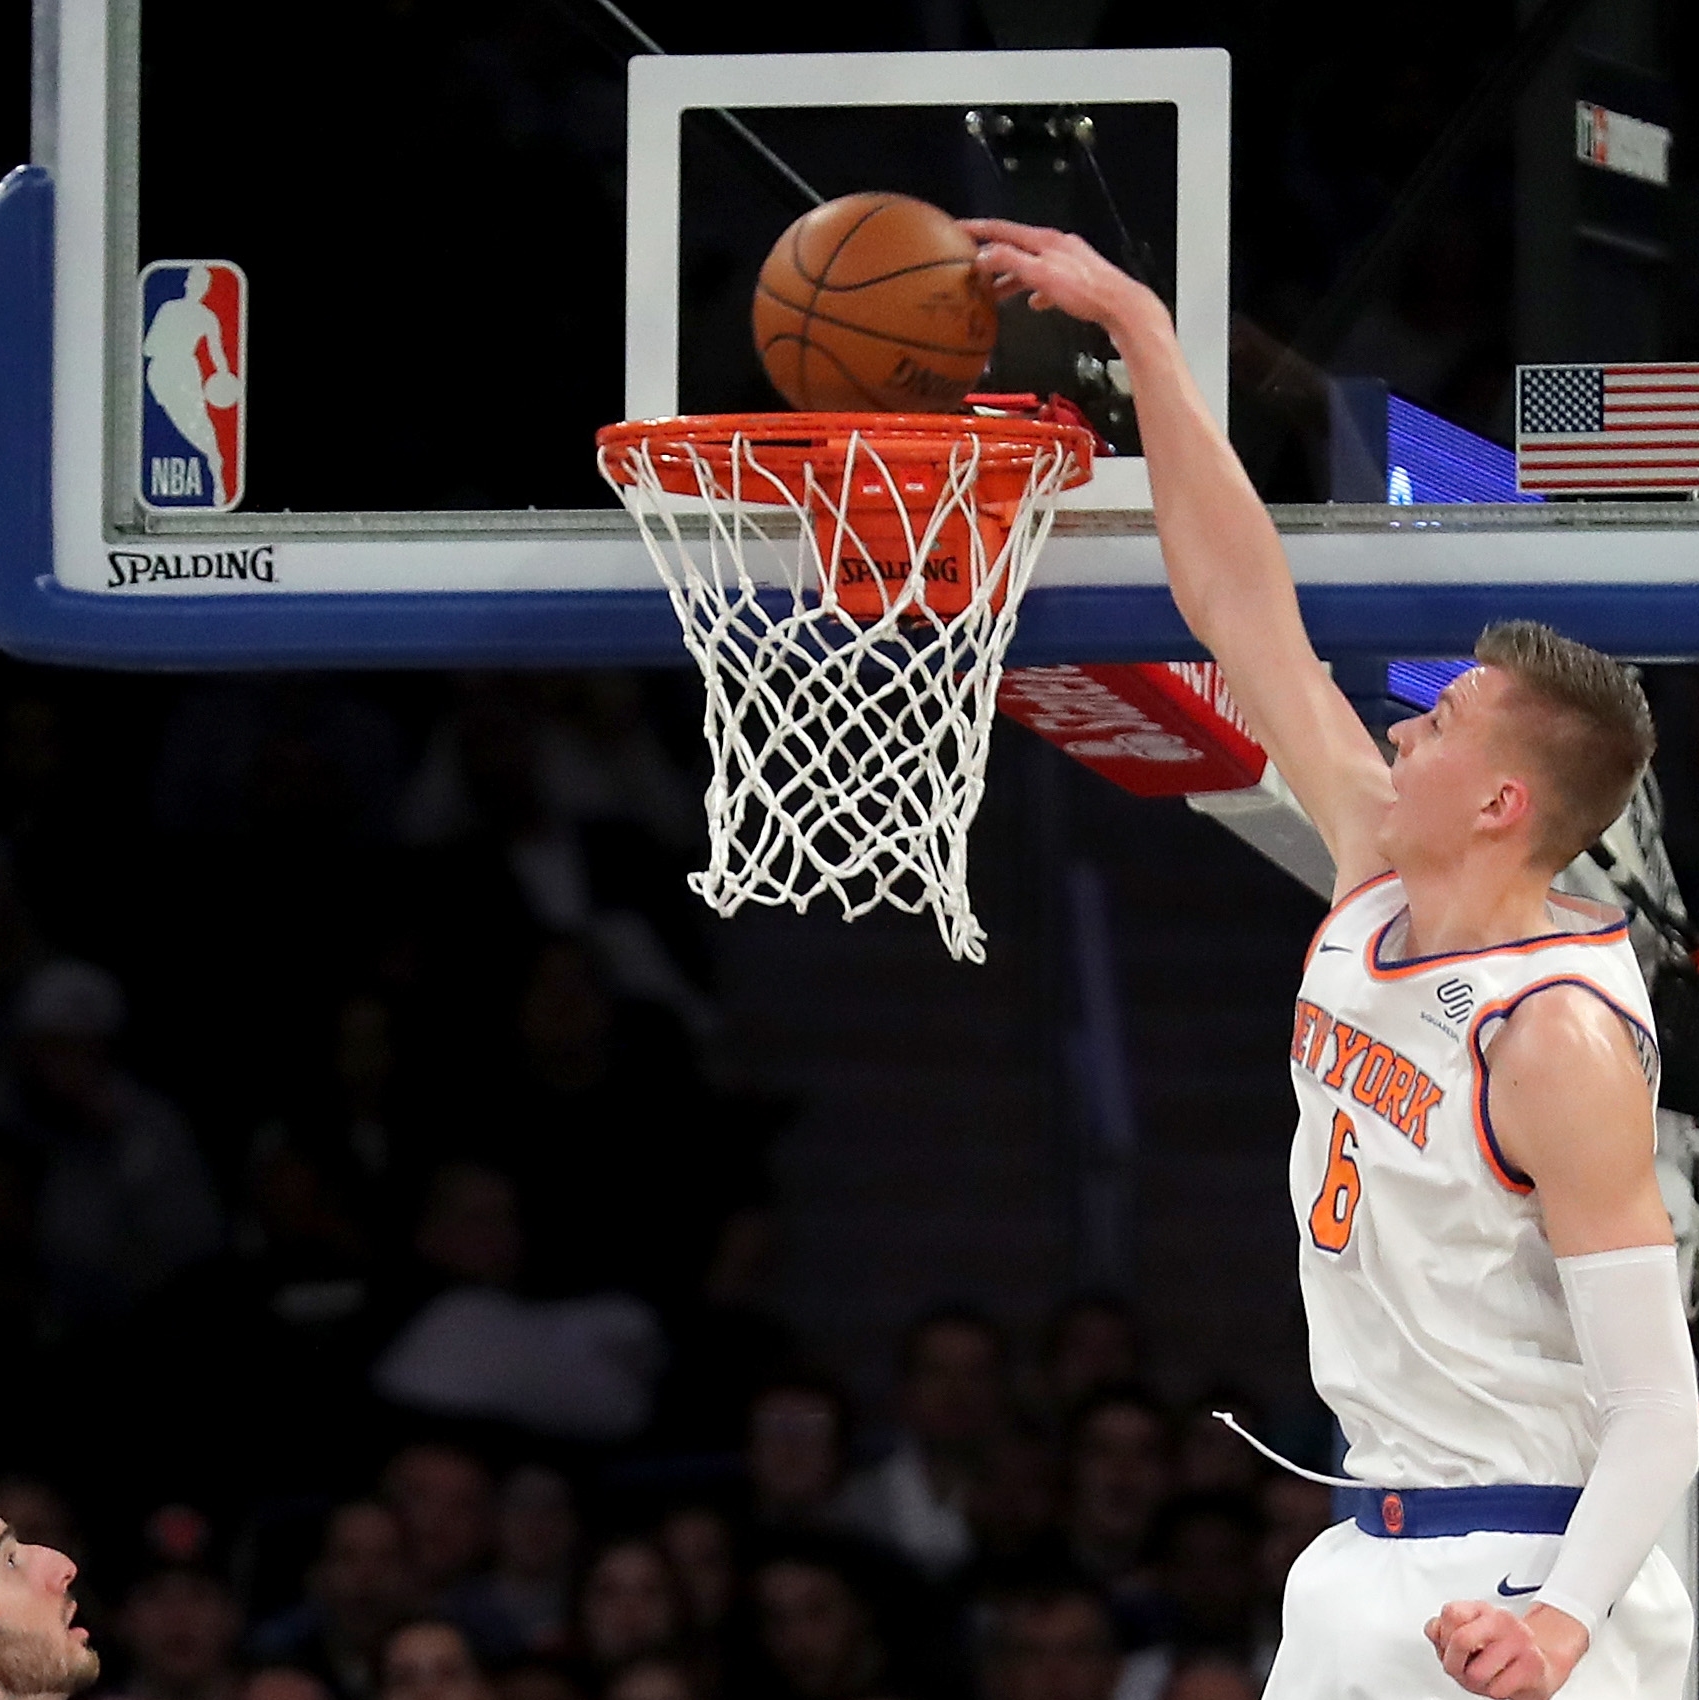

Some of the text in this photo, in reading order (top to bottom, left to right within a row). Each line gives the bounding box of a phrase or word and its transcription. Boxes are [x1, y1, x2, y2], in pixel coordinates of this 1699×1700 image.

[151, 456, 203, 496] NBA
[108, 545, 275, 588] SPALDING
[841, 557, 960, 586] SPALDNG
[1323, 1020, 1444, 1154] YORK
[1309, 1106, 1362, 1254] 6
